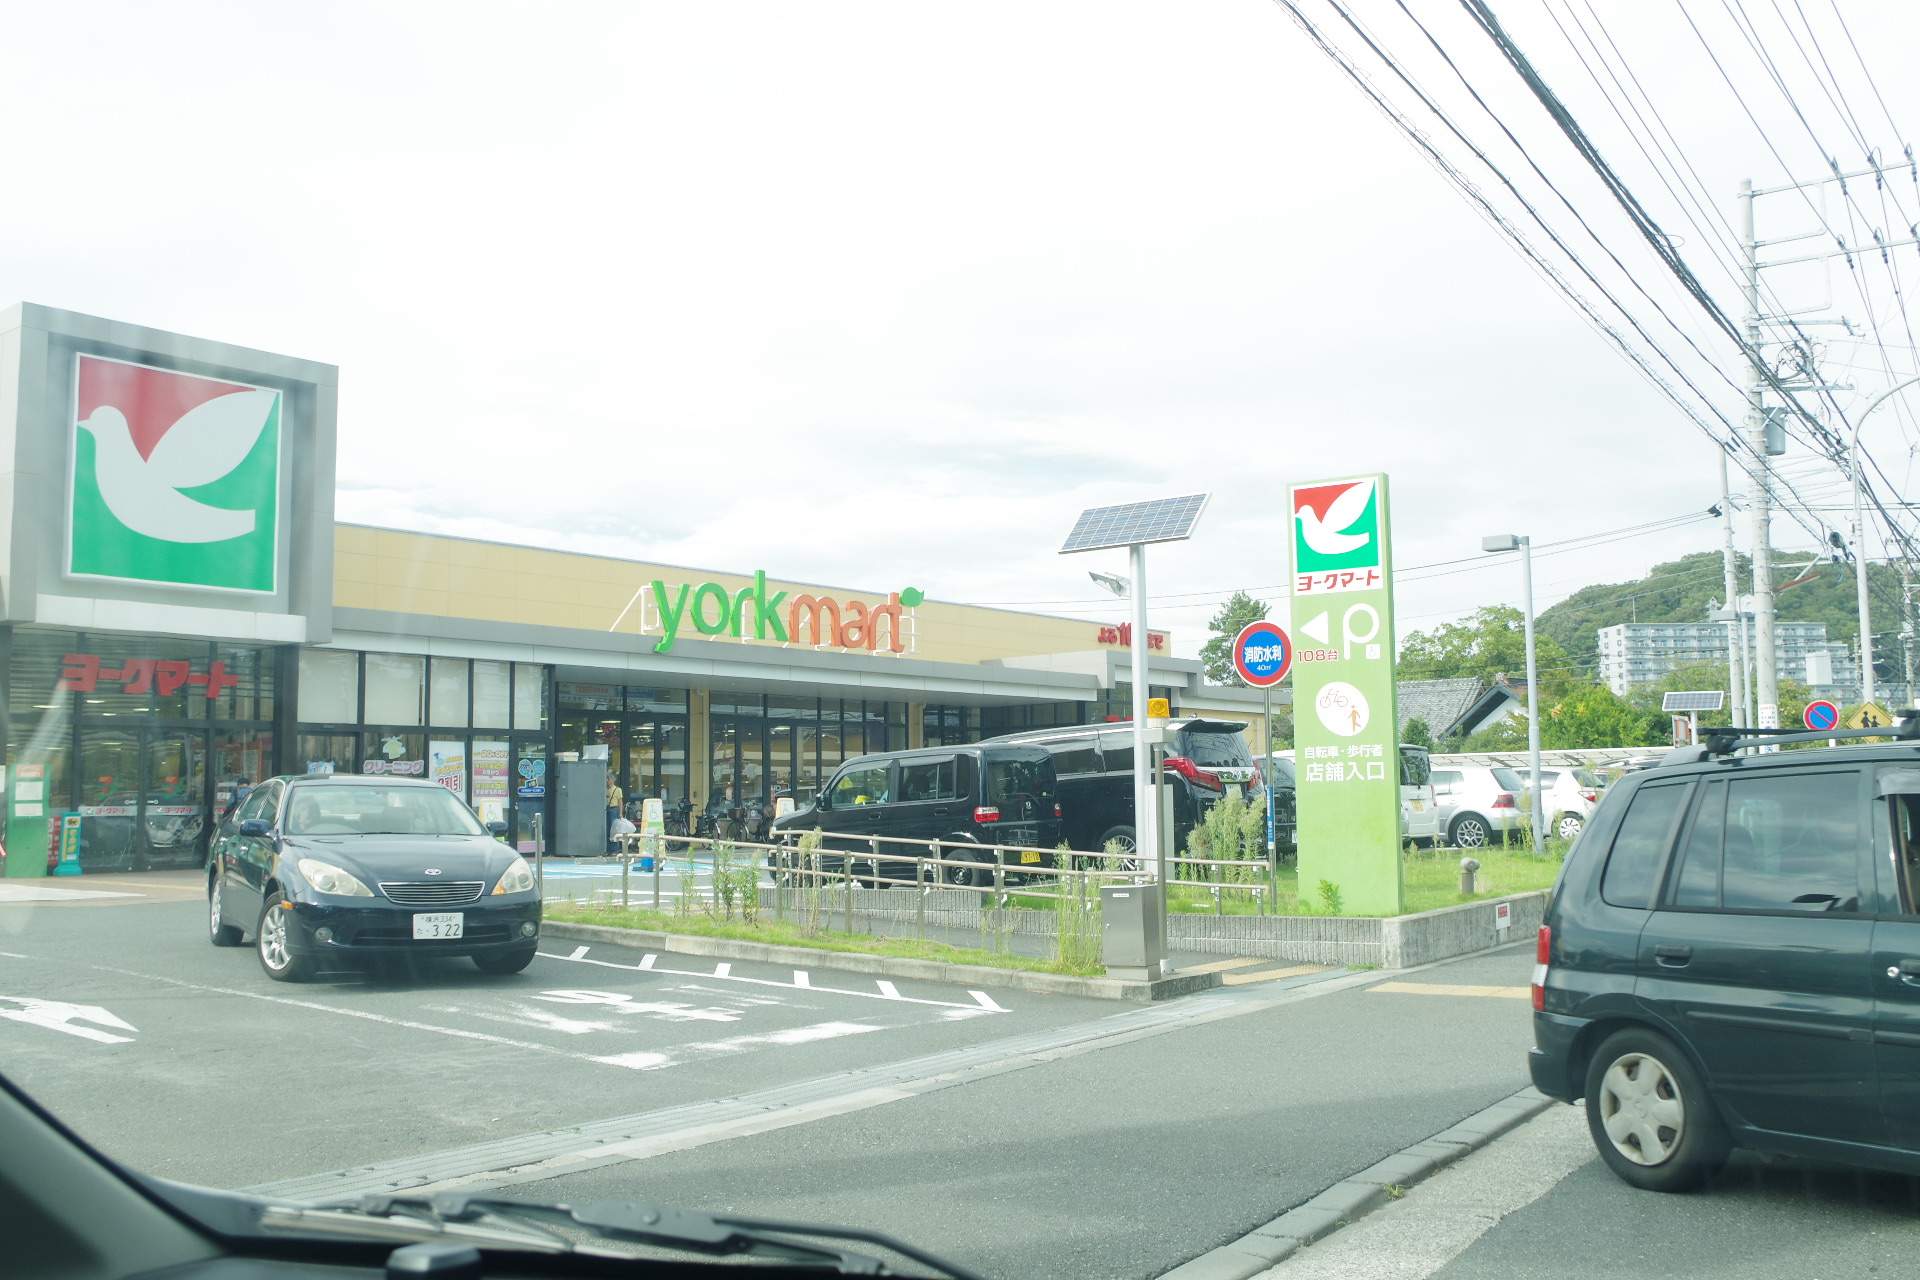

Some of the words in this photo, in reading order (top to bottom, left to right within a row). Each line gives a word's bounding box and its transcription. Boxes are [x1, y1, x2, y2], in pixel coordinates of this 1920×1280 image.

[1297, 569, 1380, 592] ヨークマート
[651, 570, 904, 654] yorkmart
[1244, 644, 1282, 664] 消防水利
[1297, 649, 1338, 662] 108台
[63, 653, 240, 700] ヨークマート
[1305, 761, 1385, 783] 店舗入口
